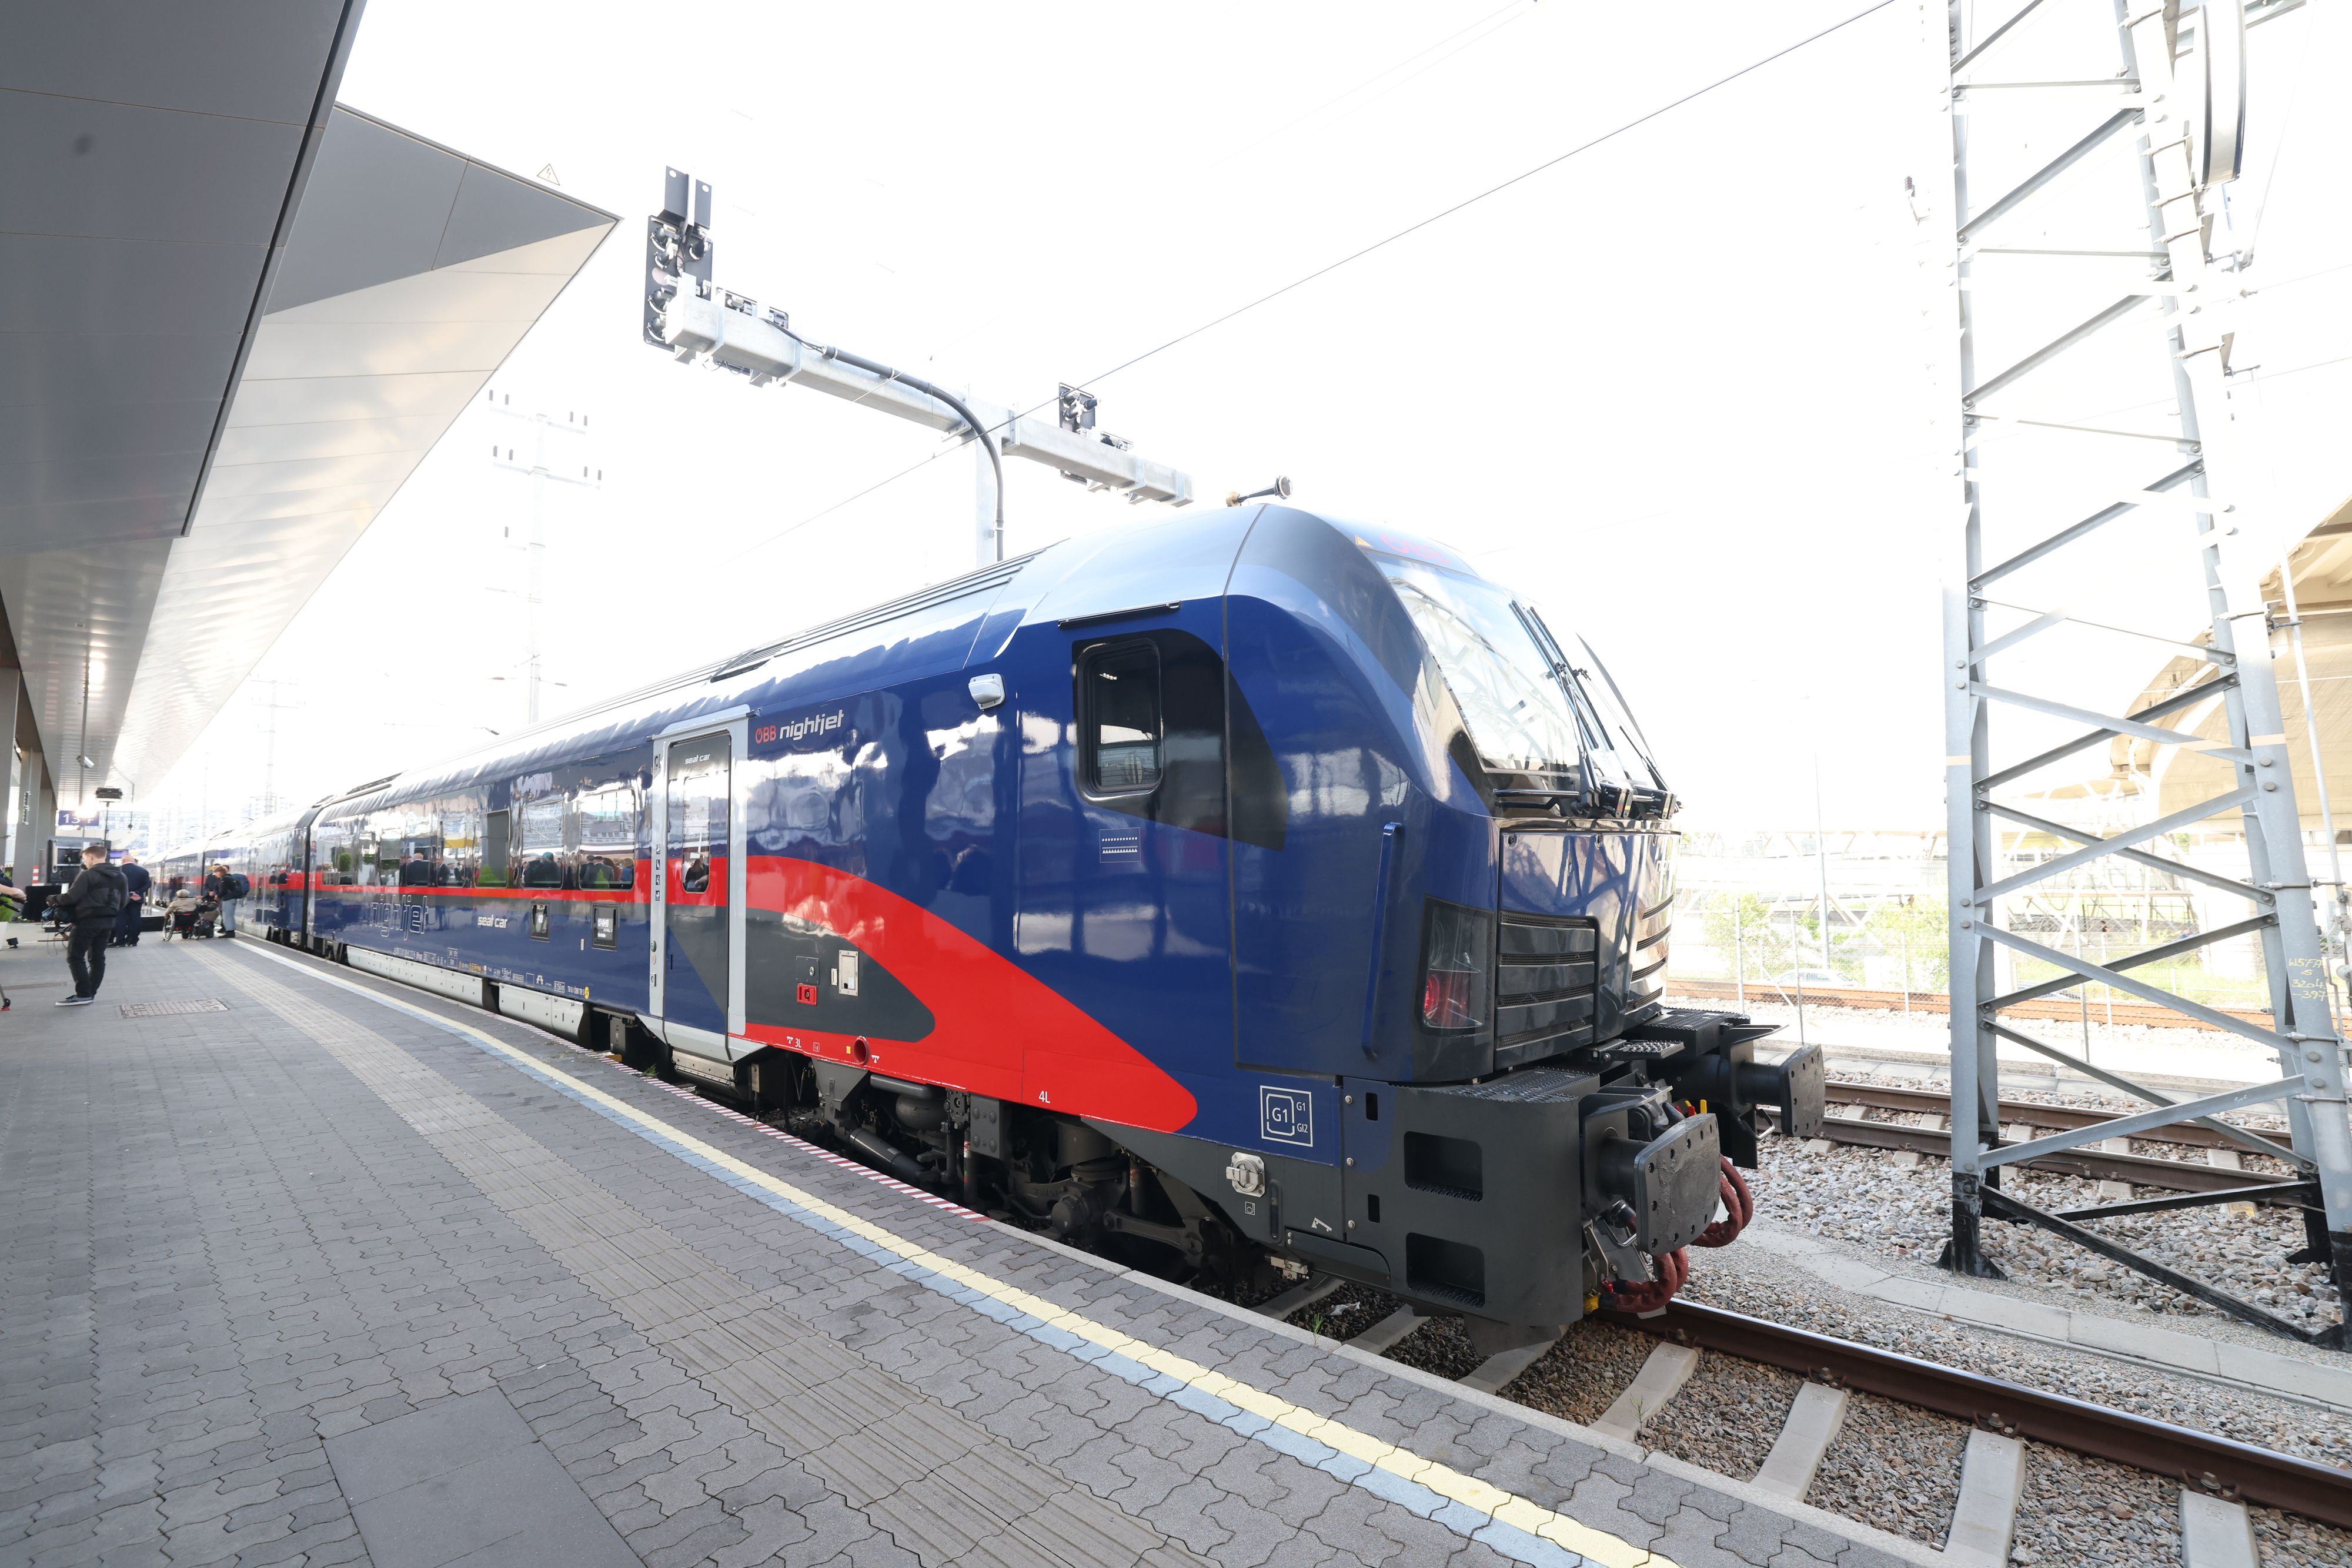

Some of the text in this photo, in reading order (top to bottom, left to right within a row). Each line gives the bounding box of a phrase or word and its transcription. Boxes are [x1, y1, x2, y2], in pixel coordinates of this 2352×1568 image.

[779, 709, 844, 741] nightjet
[684, 754, 699, 764] seat
[369, 894, 429, 941] nightjet
[477, 914, 508, 928] seat car
[795, 1038, 801, 1048] 3L
[1038, 1091, 1050, 1104] 4L
[1296, 1102, 1305, 1112] G1
[1272, 1107, 1288, 1123] G1
